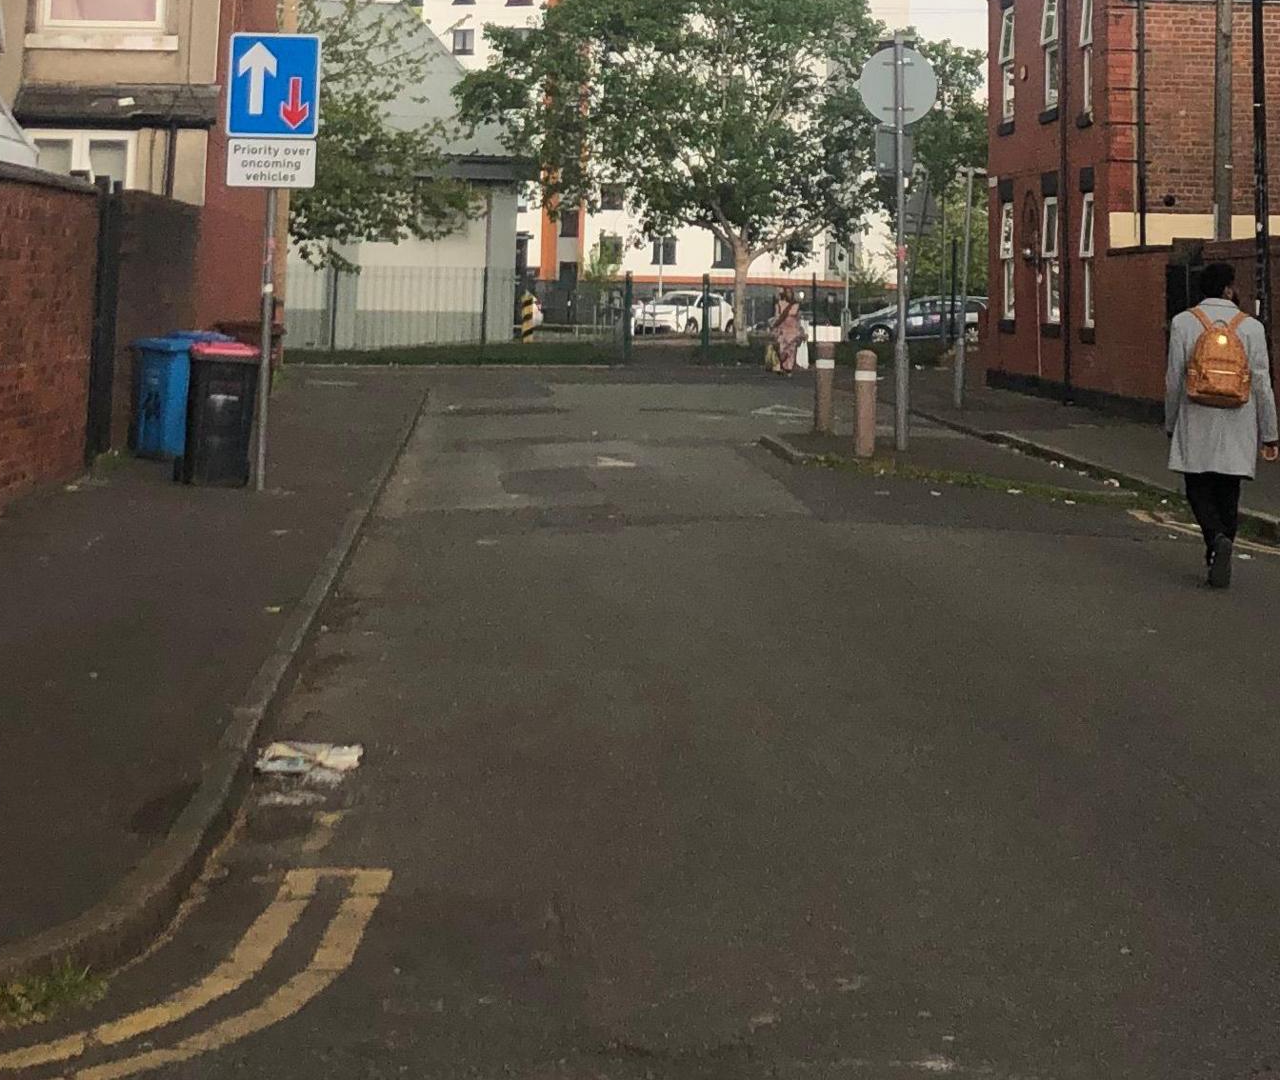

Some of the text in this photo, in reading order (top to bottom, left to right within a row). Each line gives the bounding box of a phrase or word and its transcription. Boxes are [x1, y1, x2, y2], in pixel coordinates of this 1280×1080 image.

[233, 144, 311, 157] Priority over
[241, 159, 301, 170] oncoming
[245, 171, 296, 182] vehicles
